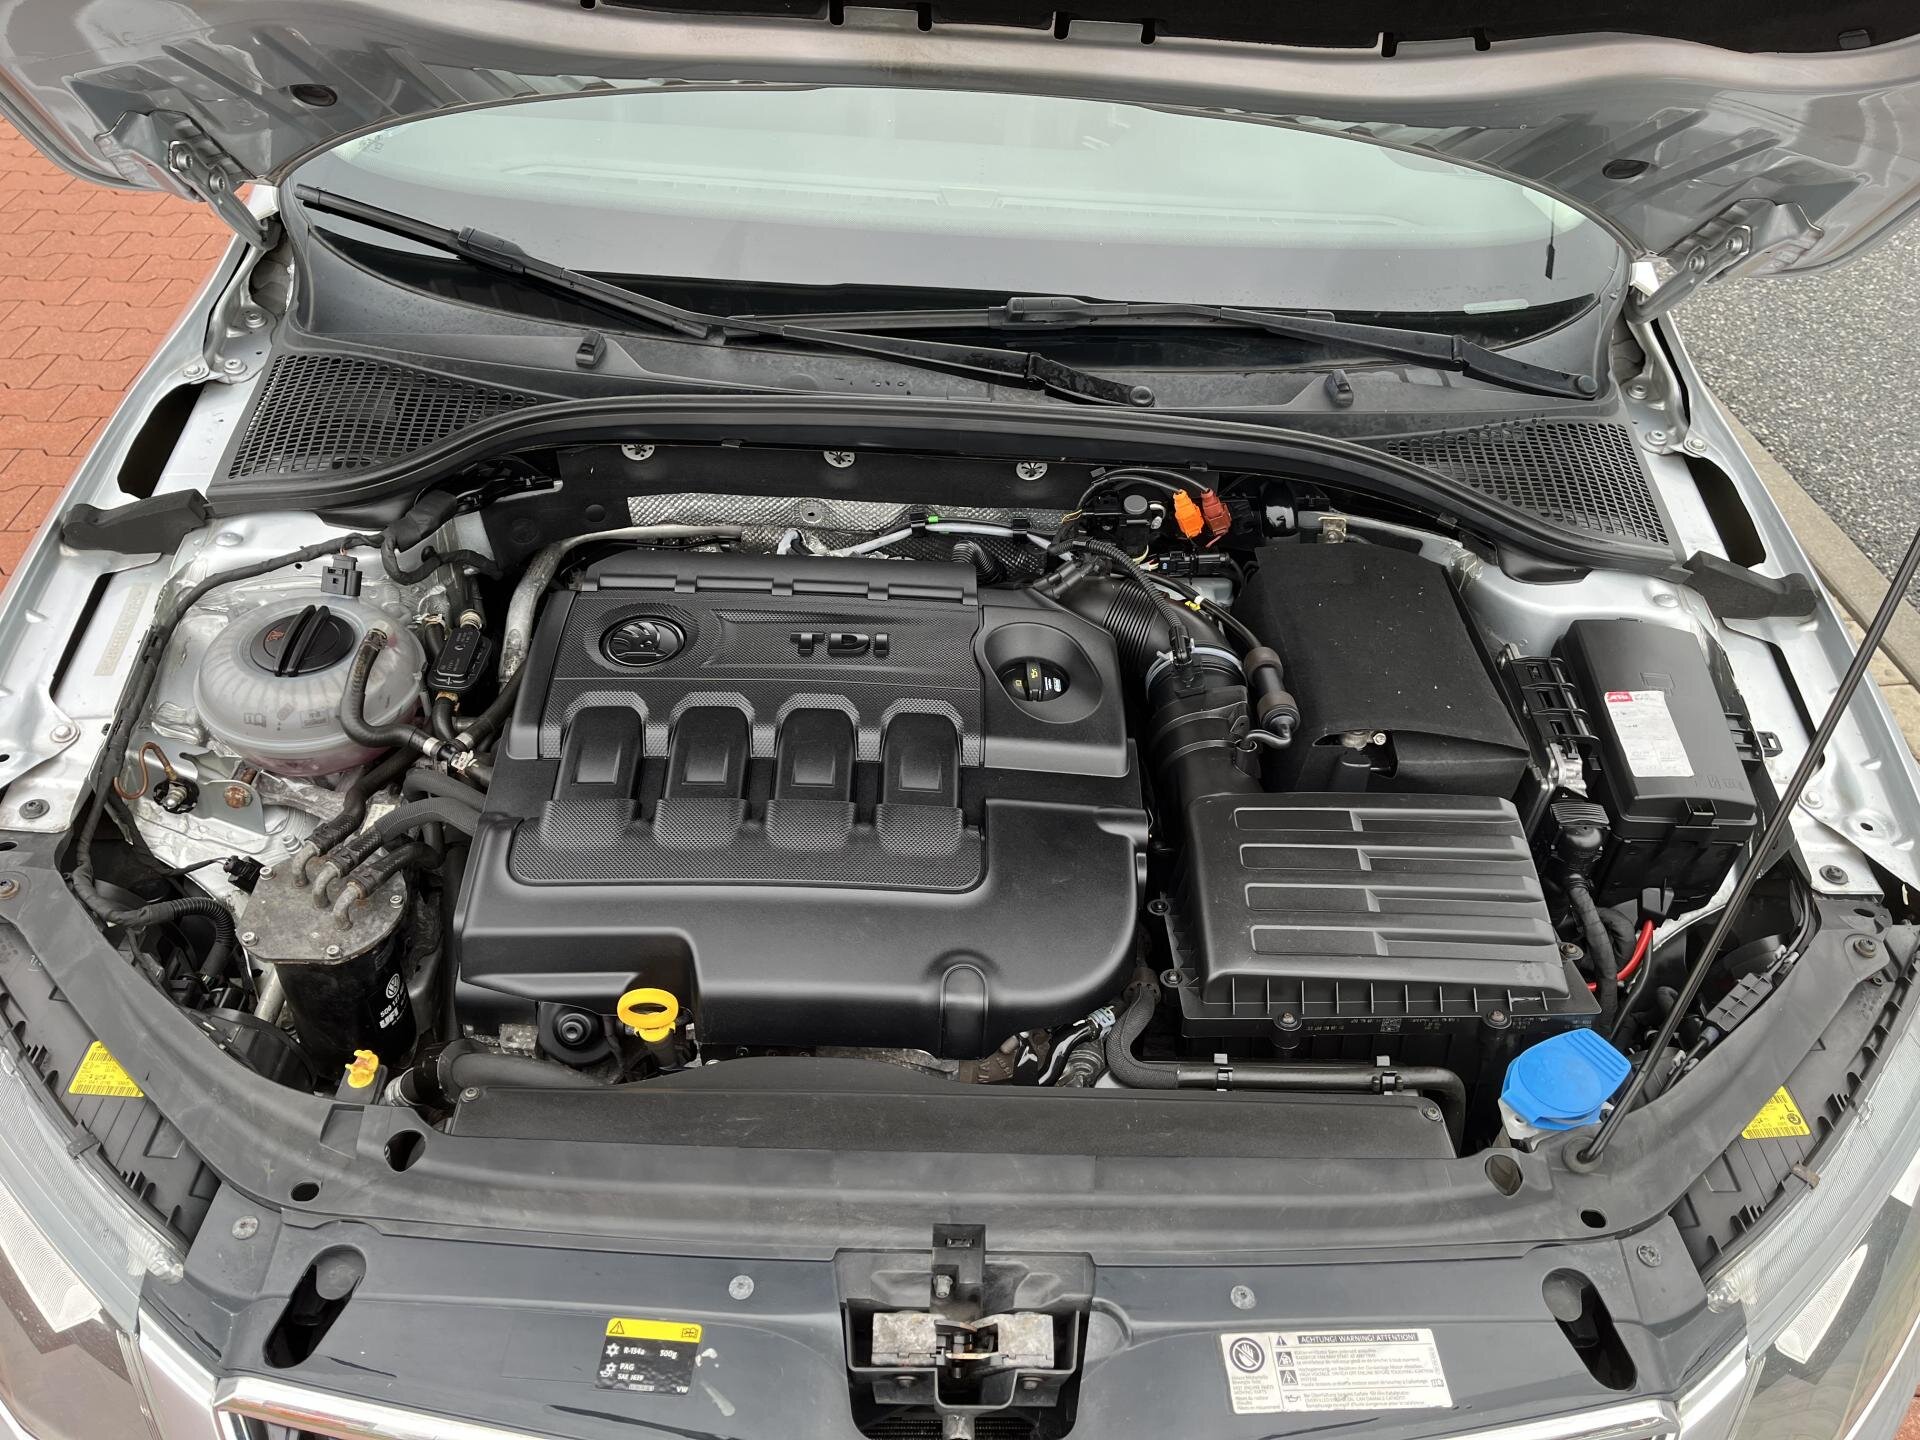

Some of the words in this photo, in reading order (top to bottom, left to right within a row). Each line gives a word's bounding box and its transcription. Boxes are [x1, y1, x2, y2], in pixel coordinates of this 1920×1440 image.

[790, 632, 889, 656] TDI
[1301, 1335, 1337, 1343] ACHTUNG!
[1338, 1334, 1374, 1342] WARNING!
[1376, 1333, 1417, 1341] ATTENTION!
[623, 1346, 646, 1355] R-134a
[619, 1362, 635, 1370] PAG
